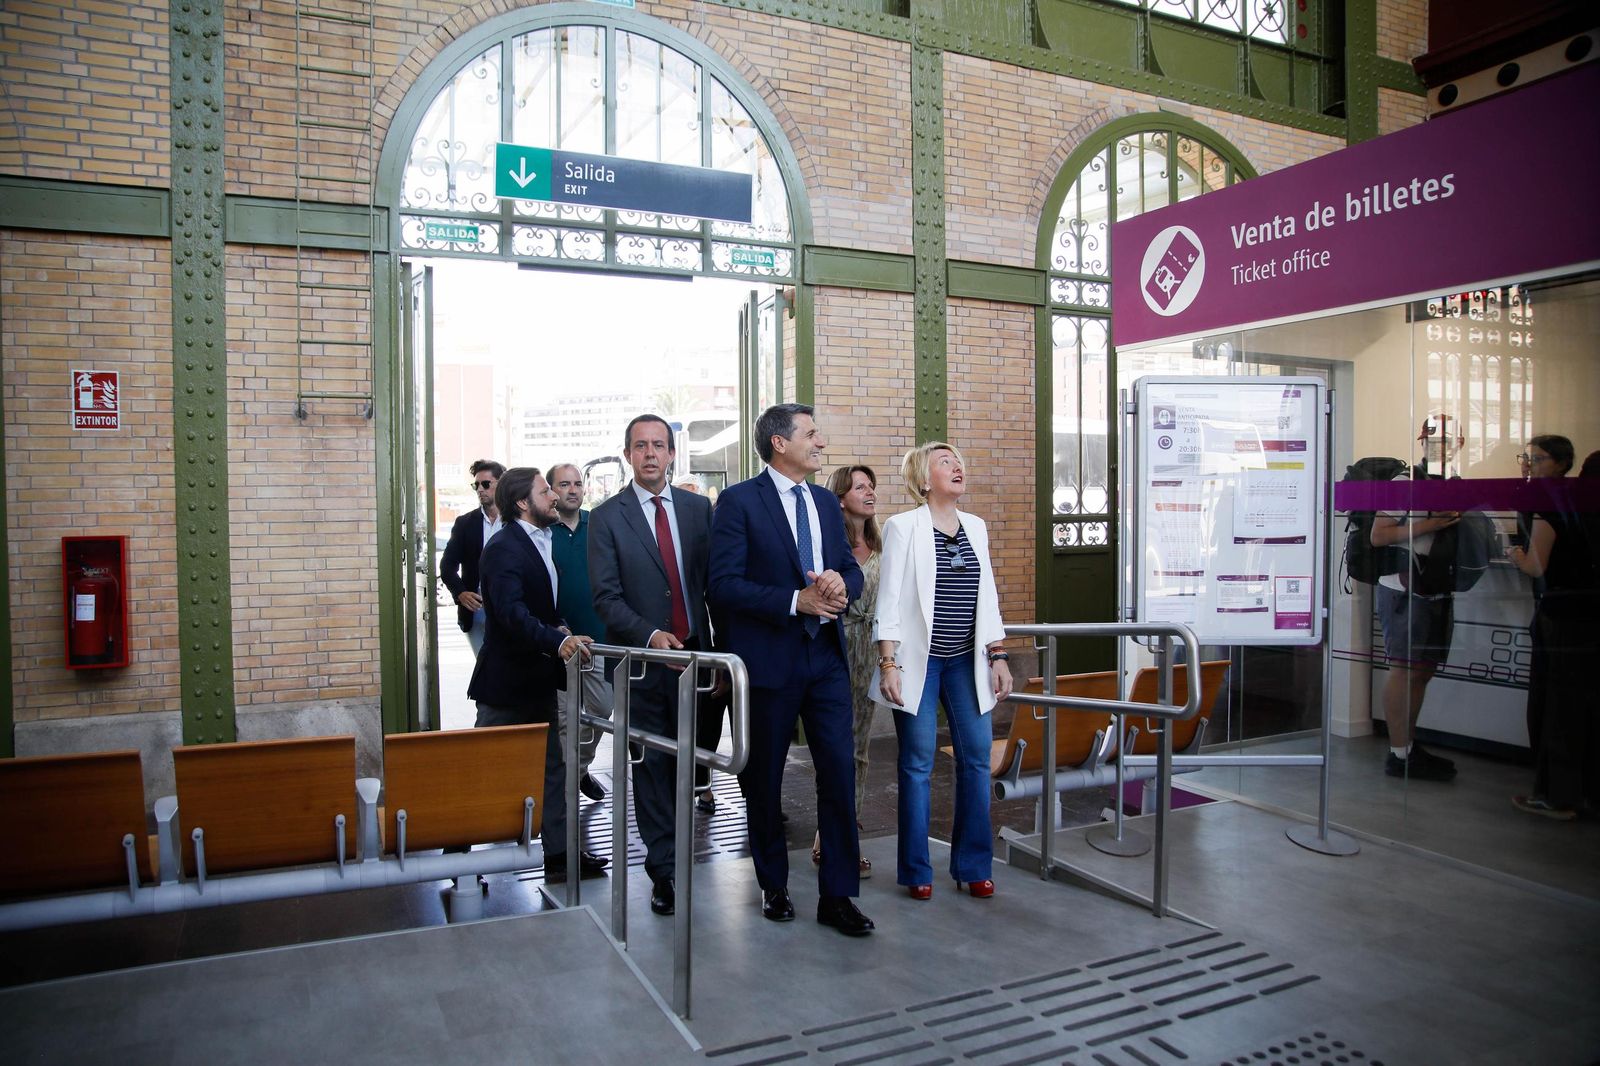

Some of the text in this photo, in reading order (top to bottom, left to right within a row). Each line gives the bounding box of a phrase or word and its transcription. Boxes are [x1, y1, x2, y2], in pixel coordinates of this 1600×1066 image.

[564, 161, 616, 184] Salida
[564, 184, 588, 196] EXIT
[1231, 173, 1456, 249] Venta de billetes
[428, 226, 477, 240] SALIDA
[733, 252, 773, 265] SALIDA
[1231, 246, 1331, 286] Ticket office
[76, 415, 117, 426] EXTINTOR
